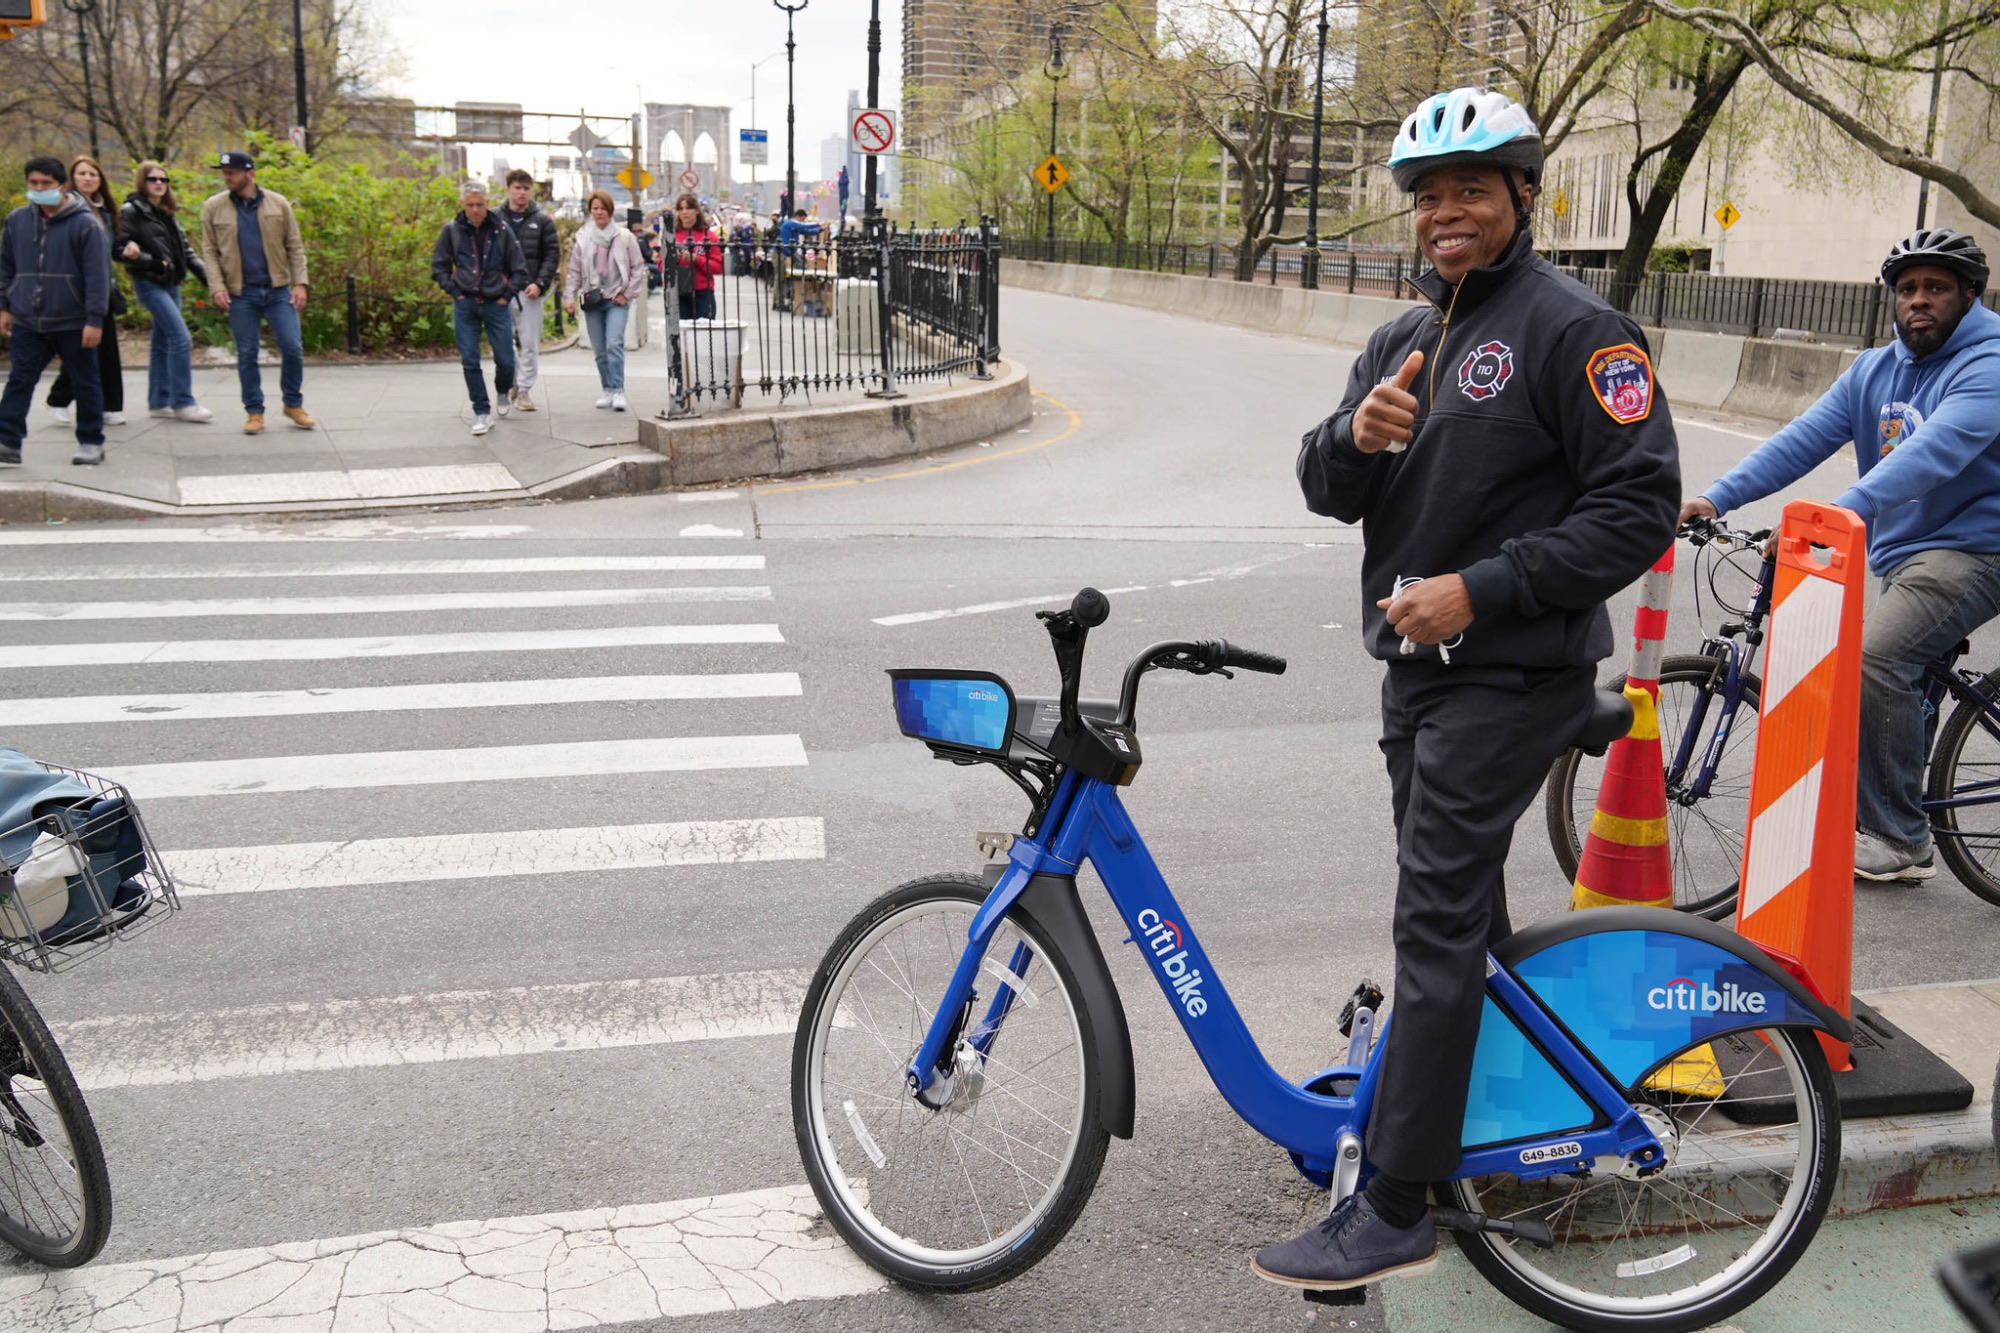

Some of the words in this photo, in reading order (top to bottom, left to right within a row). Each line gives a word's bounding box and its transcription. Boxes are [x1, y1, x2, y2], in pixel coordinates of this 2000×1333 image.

[1593, 359, 1607, 375] FIRE
[1604, 351, 1644, 365] DEPARTMENT
[1604, 368, 1620, 377] NEW
[1620, 363, 1637, 373] YORK
[1608, 360, 1622, 369] CITY
[1476, 365, 1494, 376] 110
[968, 689, 981, 700] citi
[981, 690, 999, 702] bike
[1138, 908, 1182, 957] citi
[1161, 950, 1208, 1018] bike
[1648, 977, 1698, 1011] citi
[1701, 981, 1766, 1013] bike
[1522, 1144, 1579, 1162] 649-8836
[951, 1267, 971, 1275] PLUS
